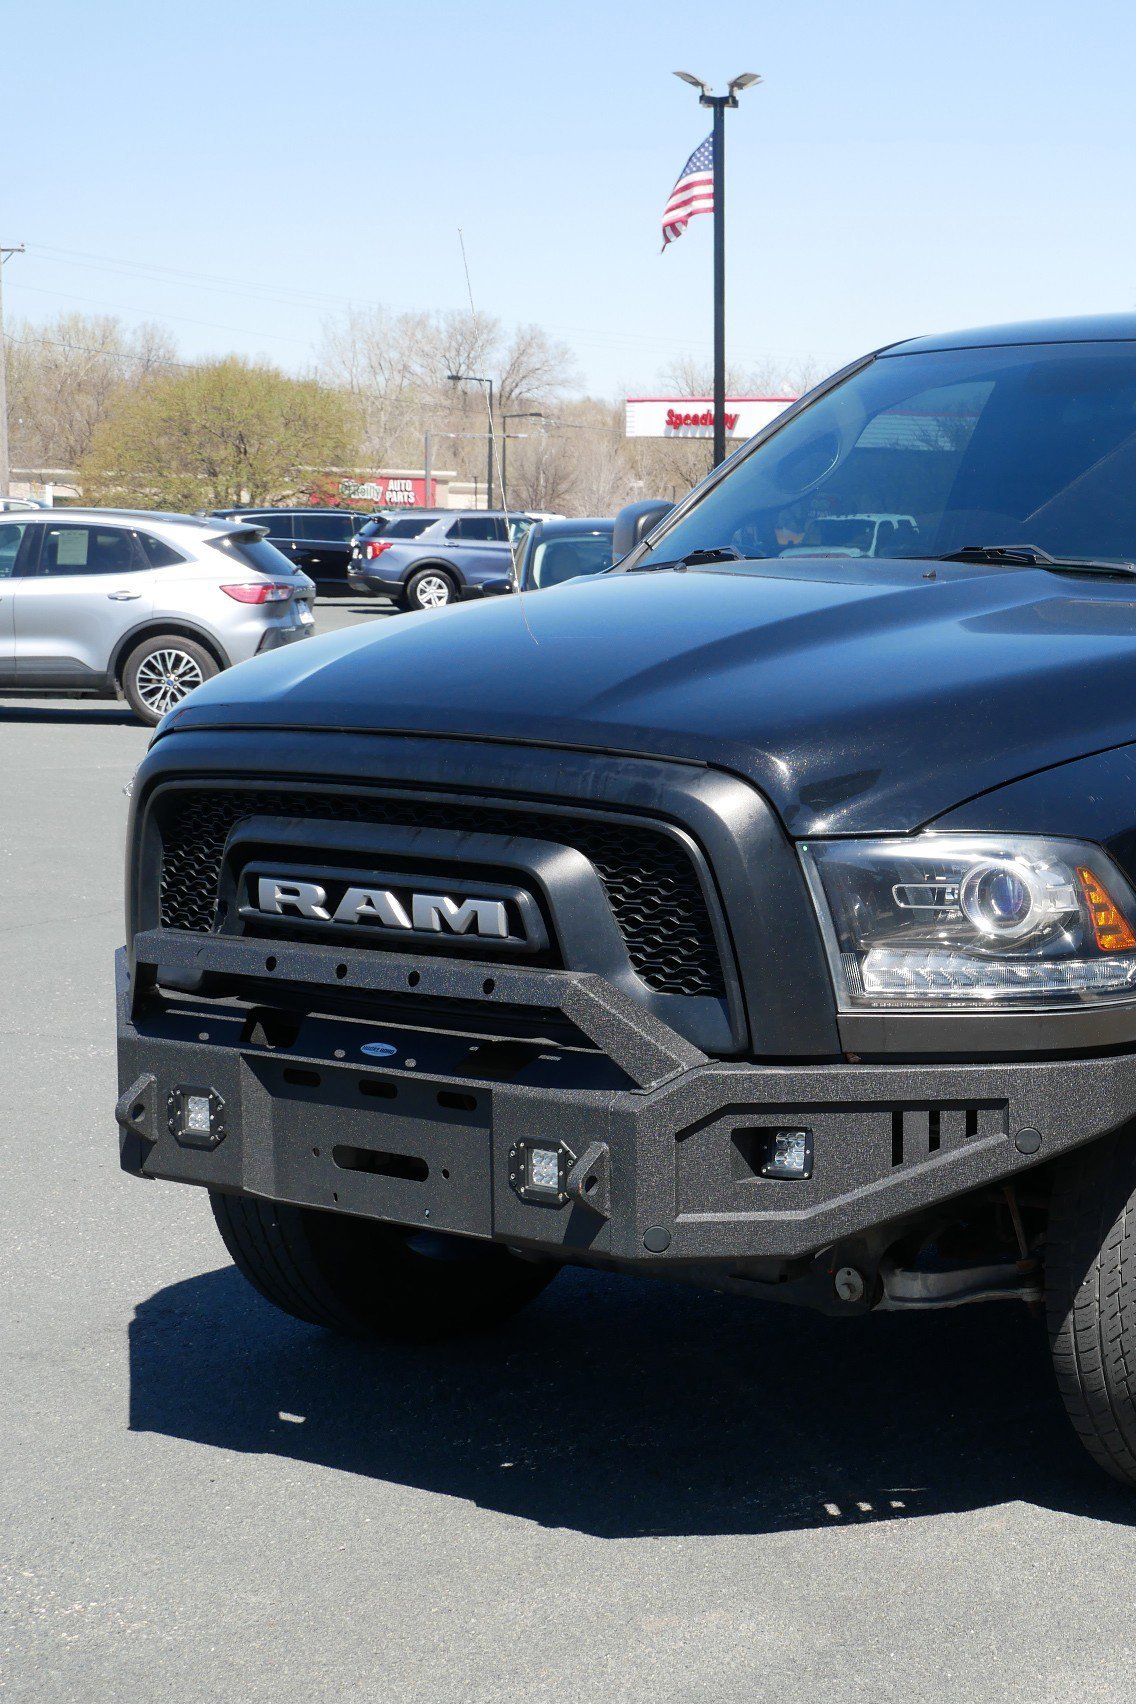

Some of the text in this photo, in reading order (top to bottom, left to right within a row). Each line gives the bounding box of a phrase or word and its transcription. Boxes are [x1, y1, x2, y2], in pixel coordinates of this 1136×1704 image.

[665, 409, 739, 430] Speedy
[387, 480, 413, 491] AUTO
[385, 491, 415, 503] PARTS
[258, 877, 509, 939] RAM
